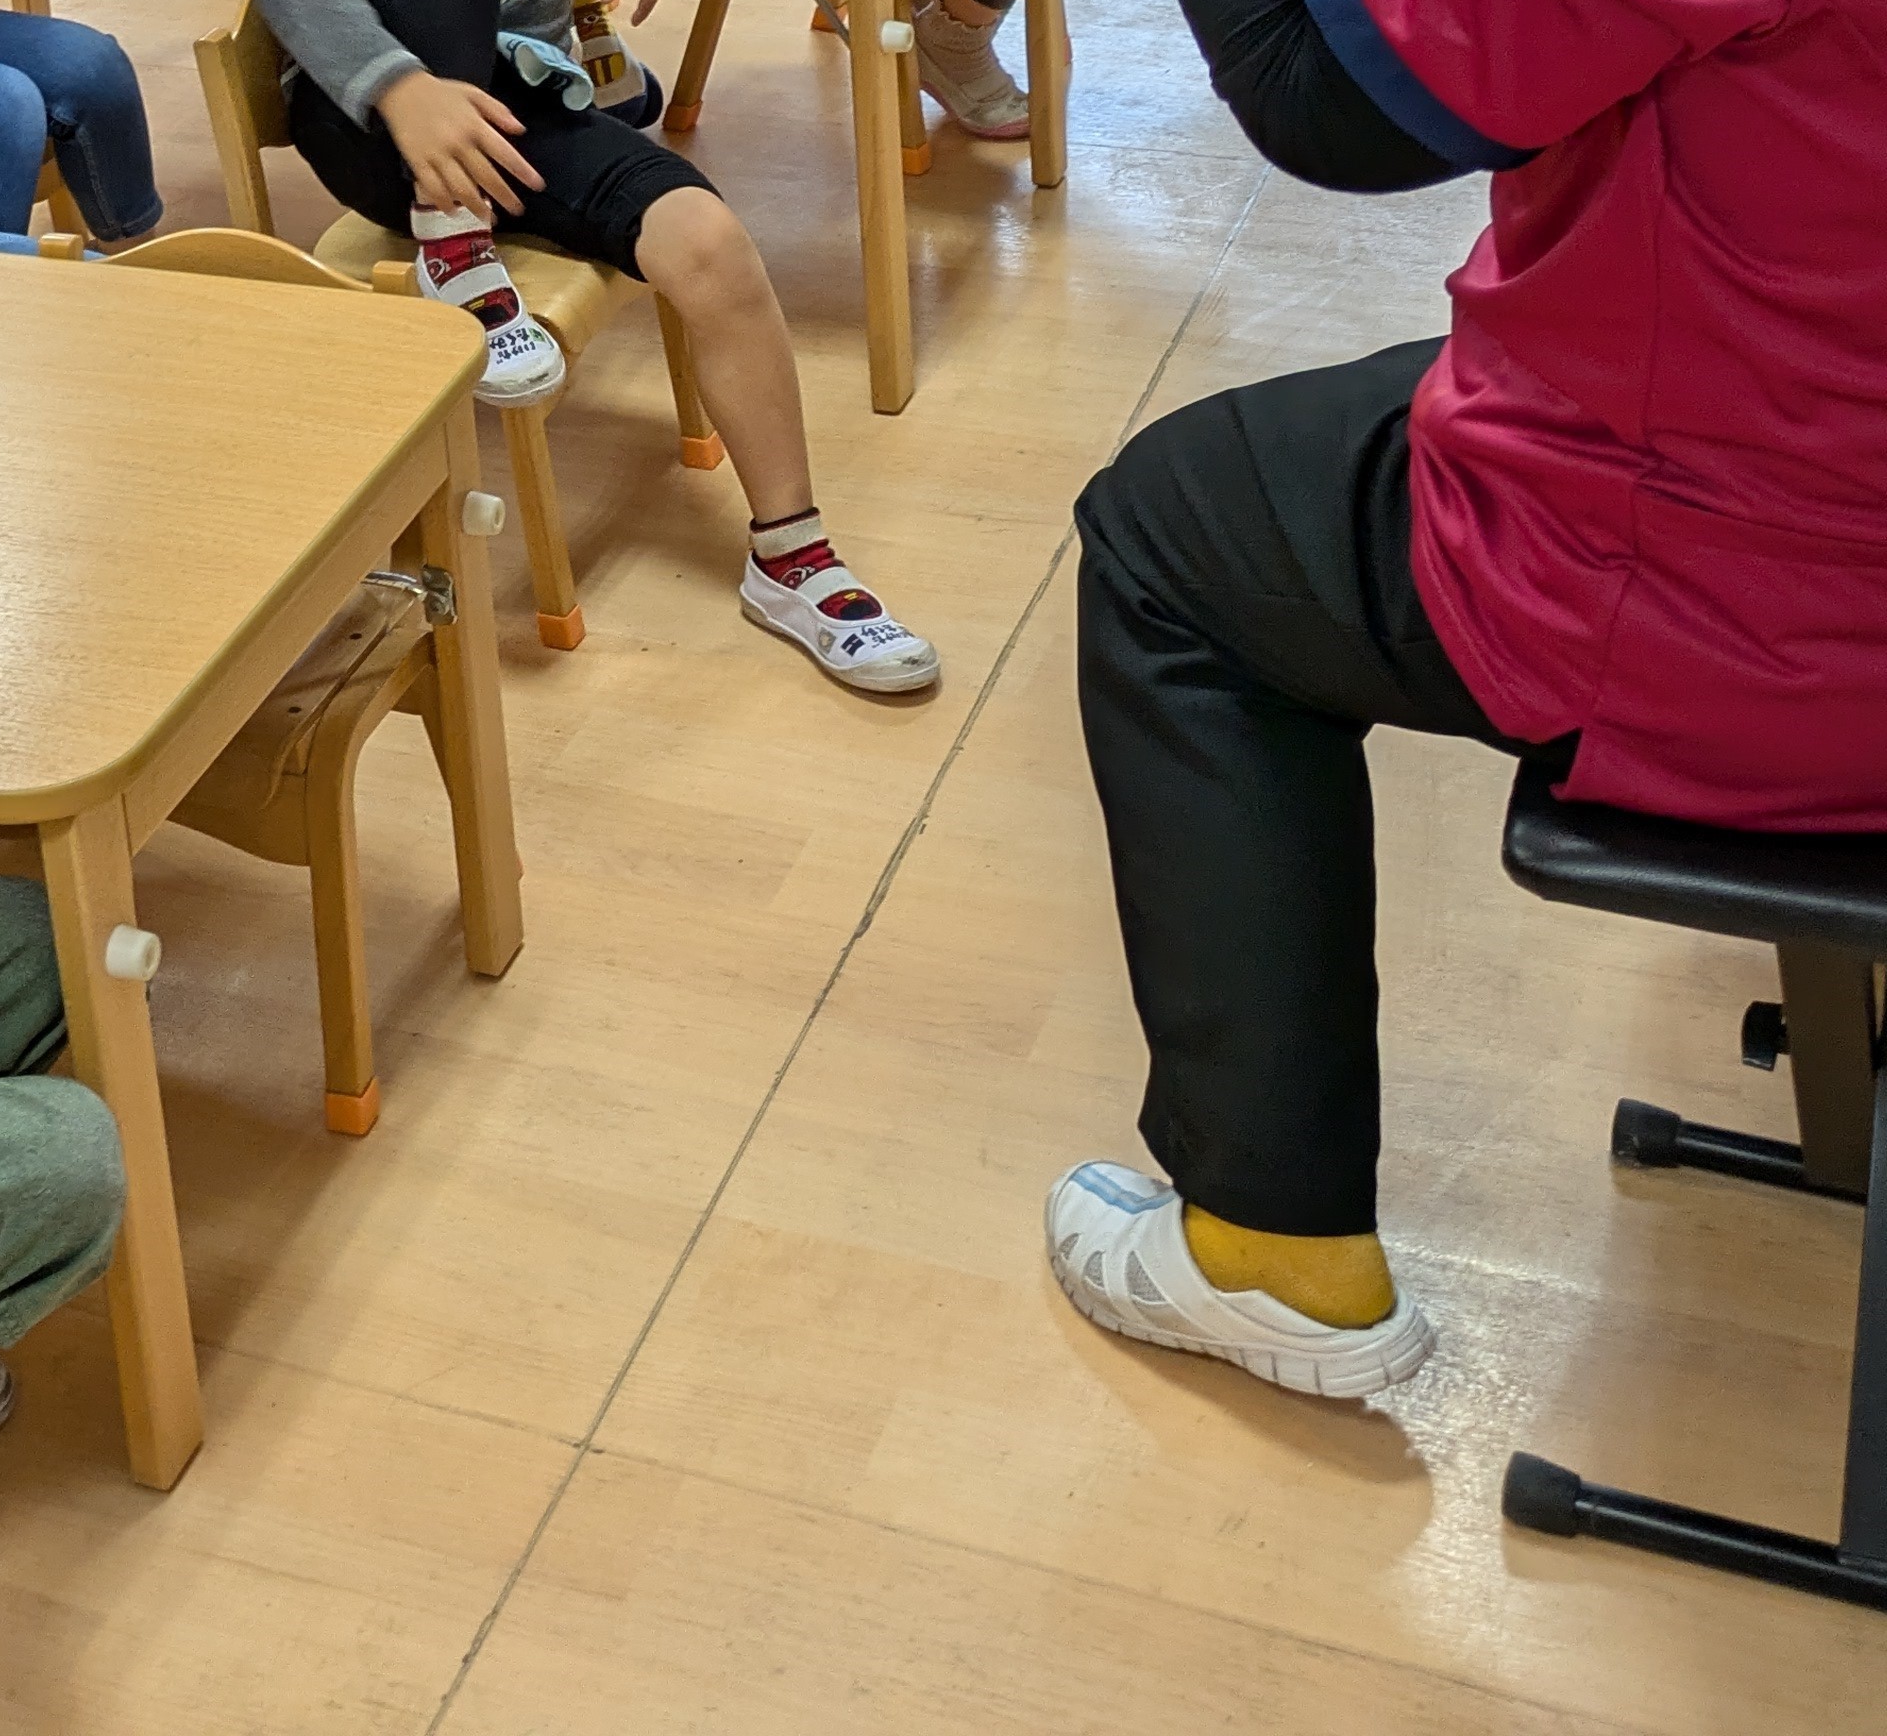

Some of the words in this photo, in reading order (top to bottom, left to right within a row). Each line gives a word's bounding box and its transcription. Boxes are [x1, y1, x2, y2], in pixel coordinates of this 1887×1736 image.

[489, 327, 529, 349] たくみ
[495, 341, 537, 364] いけだ
